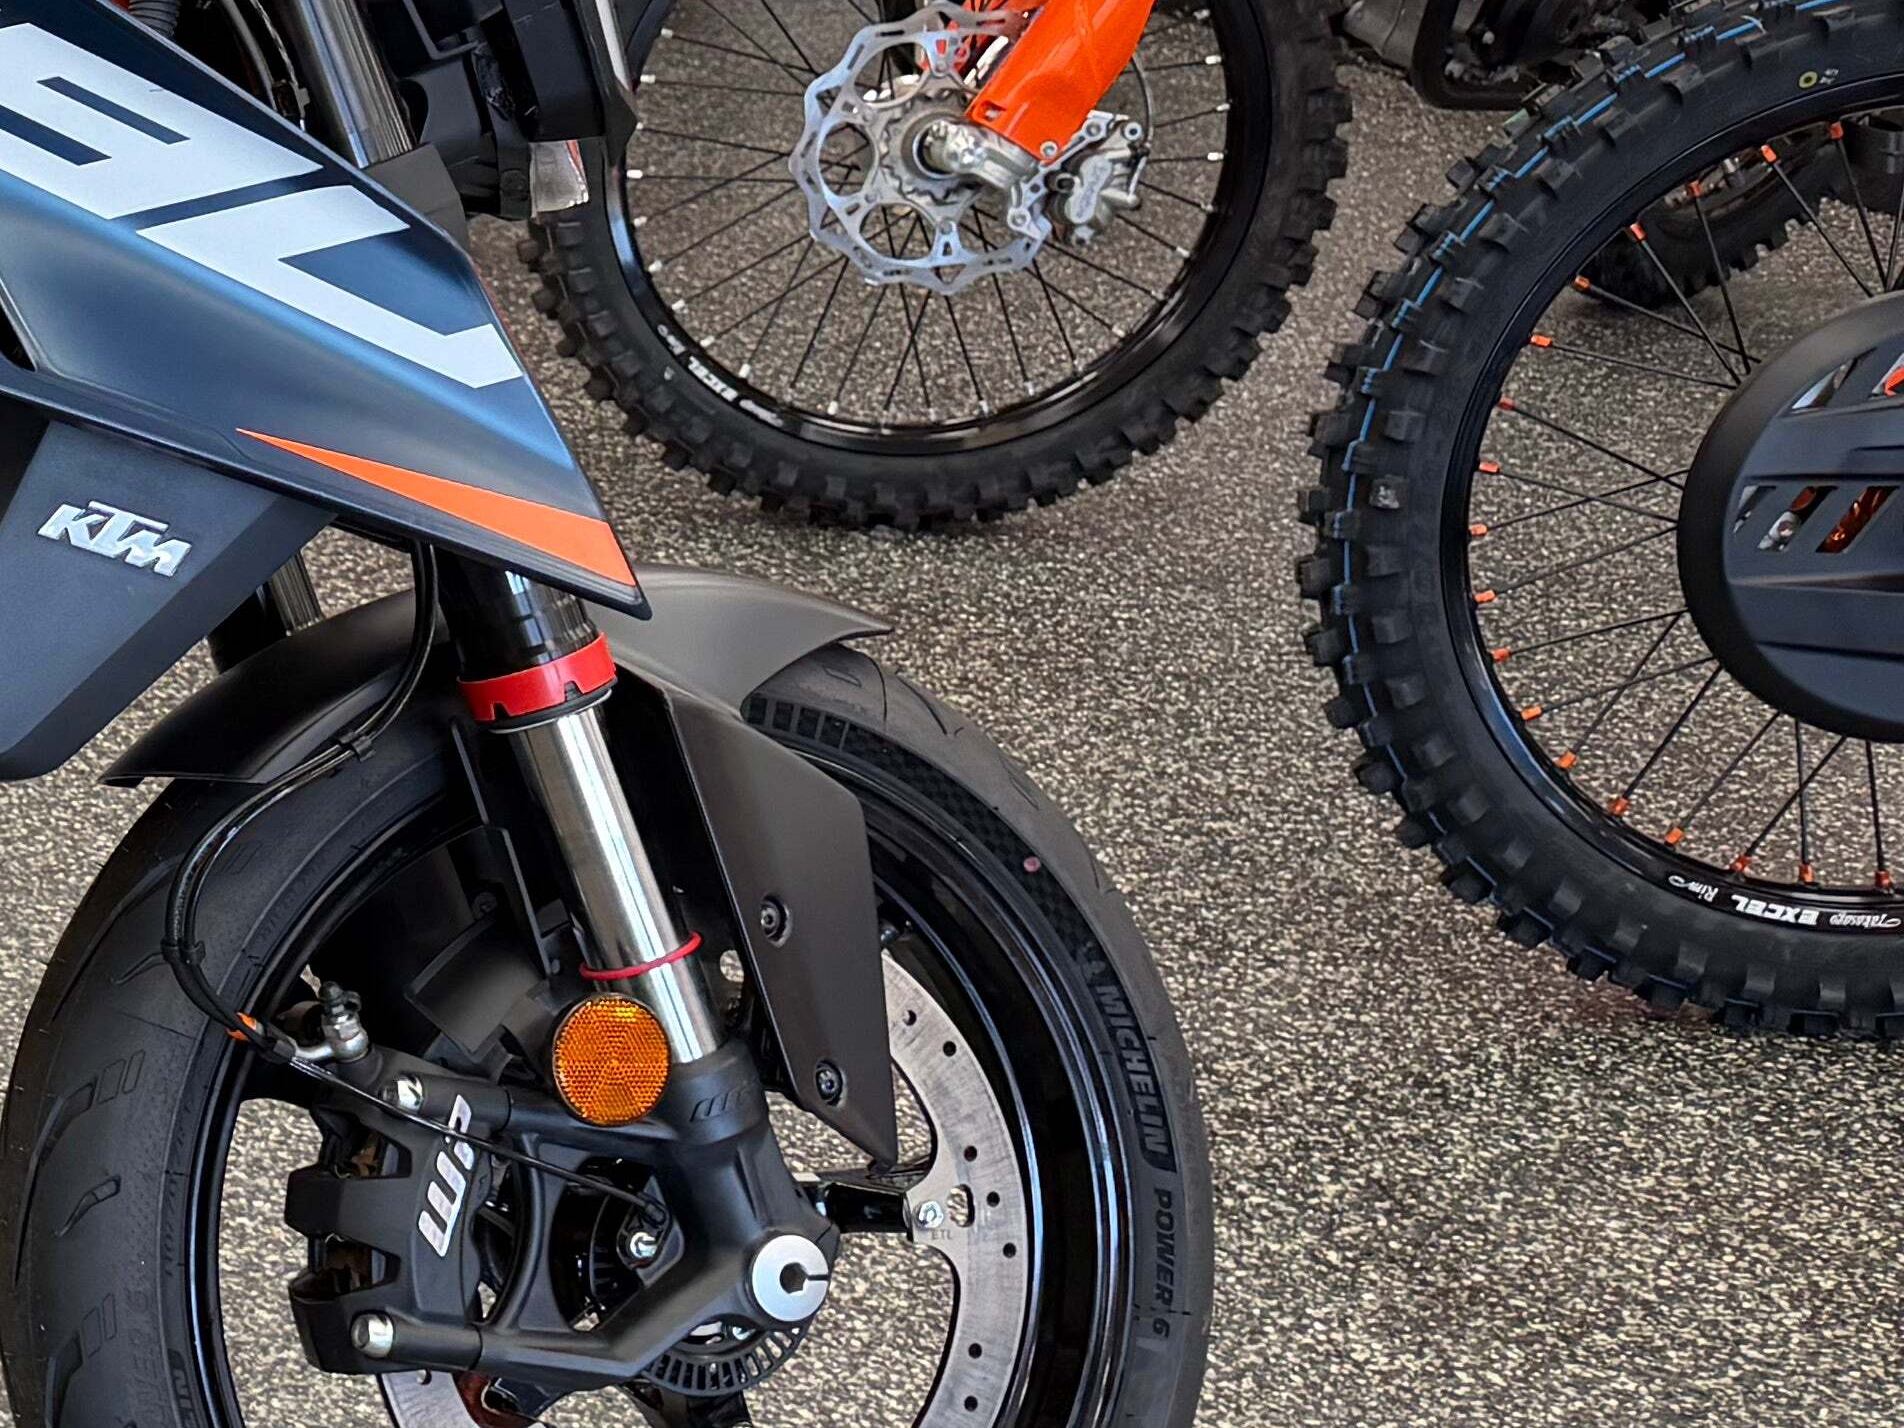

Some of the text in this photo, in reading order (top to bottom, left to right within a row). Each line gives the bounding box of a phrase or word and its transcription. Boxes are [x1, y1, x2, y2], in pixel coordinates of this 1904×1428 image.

[37, 500, 193, 578] KTM
[1730, 893, 1820, 926] EXCEL
[1095, 984, 1170, 1157] MICHELIN
[417, 1093, 476, 1258] WP
[1152, 1187, 1176, 1340] POWER 6
